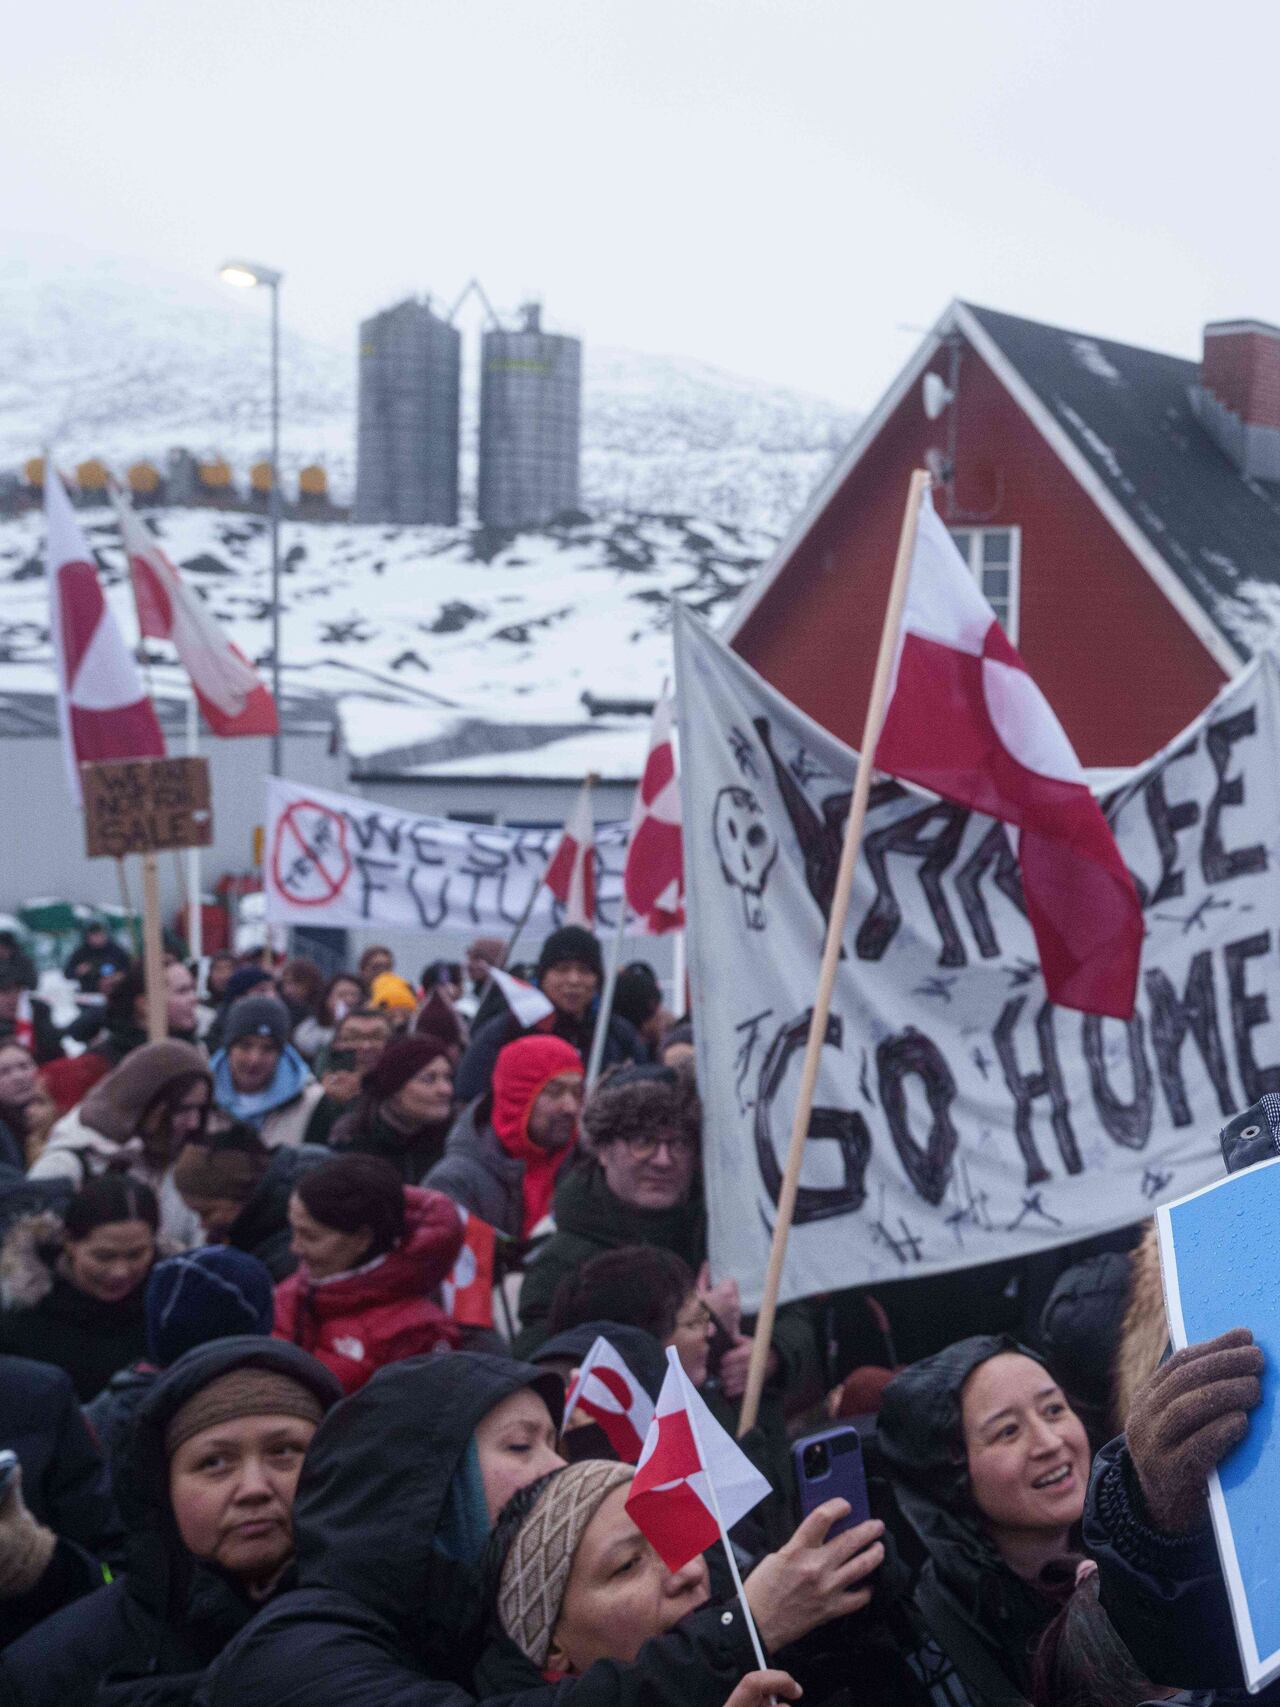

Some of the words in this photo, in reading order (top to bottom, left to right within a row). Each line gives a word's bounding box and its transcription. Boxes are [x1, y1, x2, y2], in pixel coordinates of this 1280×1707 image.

[97, 811, 189, 856] SALE
[343, 810, 445, 866] WE
[754, 704, 1268, 967] YANEE
[755, 1004, 959, 1226] GO
